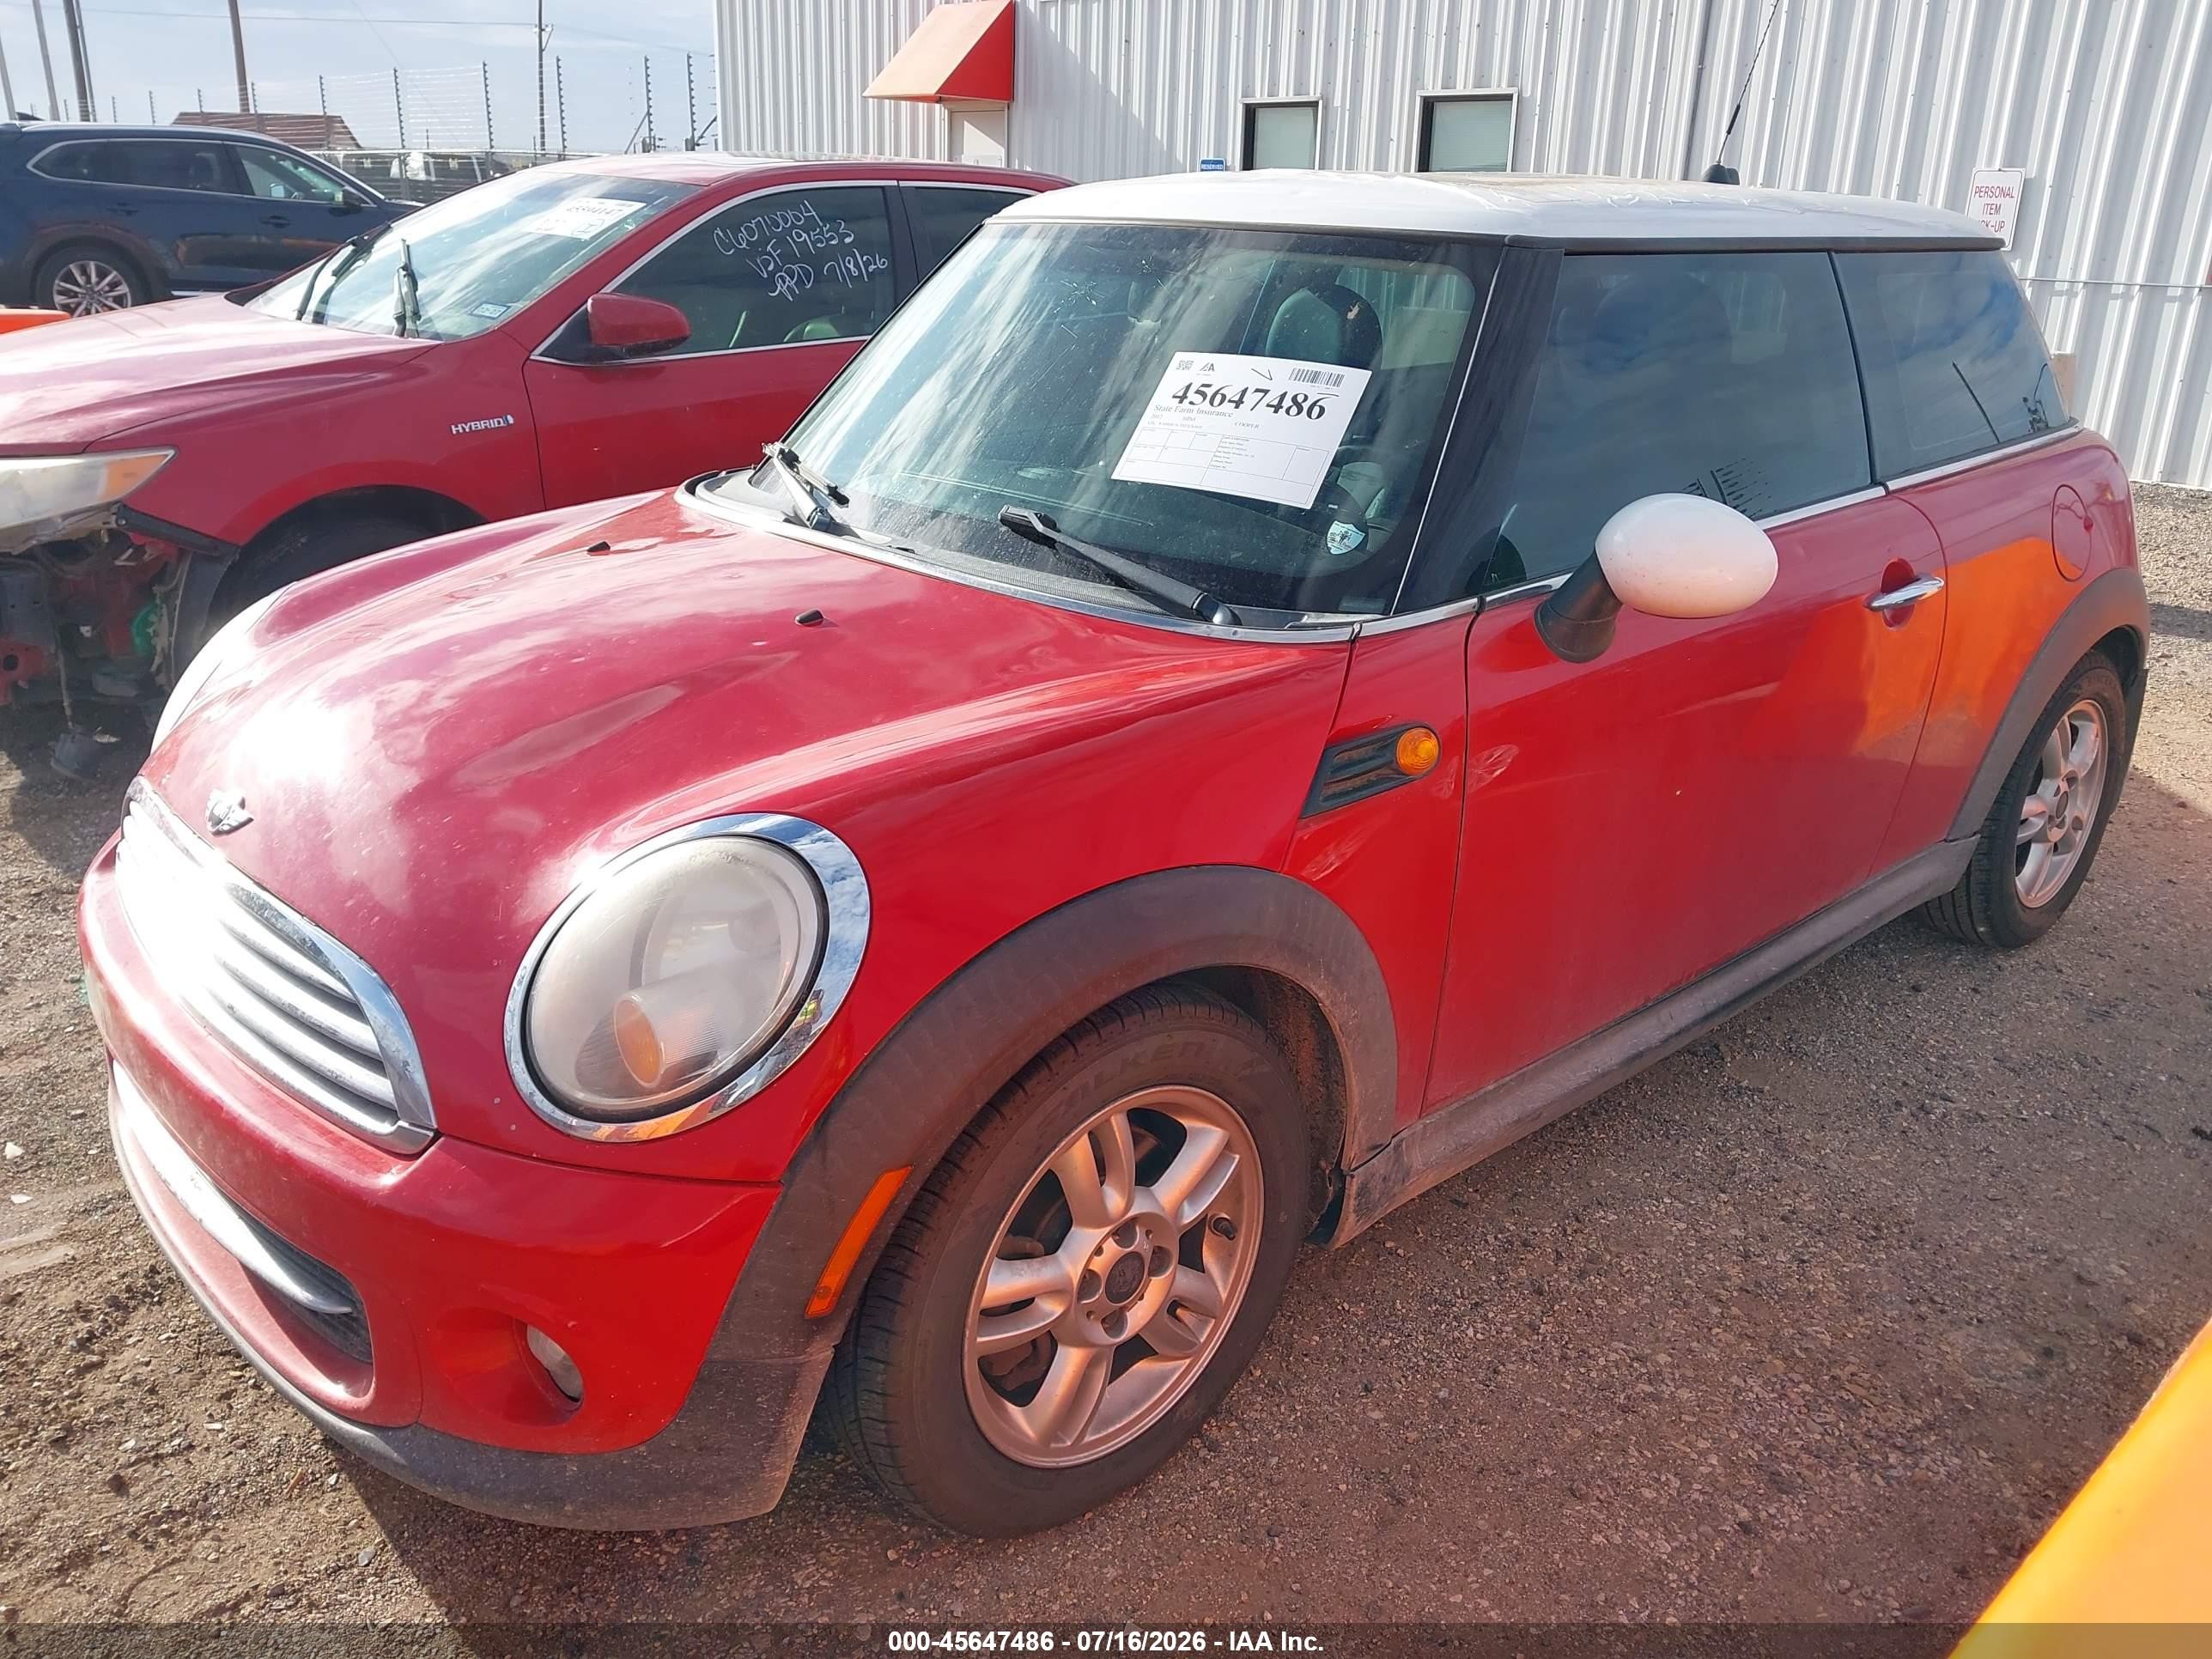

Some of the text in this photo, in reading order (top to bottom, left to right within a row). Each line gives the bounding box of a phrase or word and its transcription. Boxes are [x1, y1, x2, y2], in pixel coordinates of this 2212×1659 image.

[1973, 185, 2016, 198] PERSONAL
[1982, 203, 2002, 216] ITEM
[787, 219, 855, 258] 19553
[823, 248, 889, 289] 7/8/26
[1171, 381, 1340, 420] 45647486
[1153, 404, 1234, 418] State Farm Insurance
[451, 416, 507, 434] HYBRID
